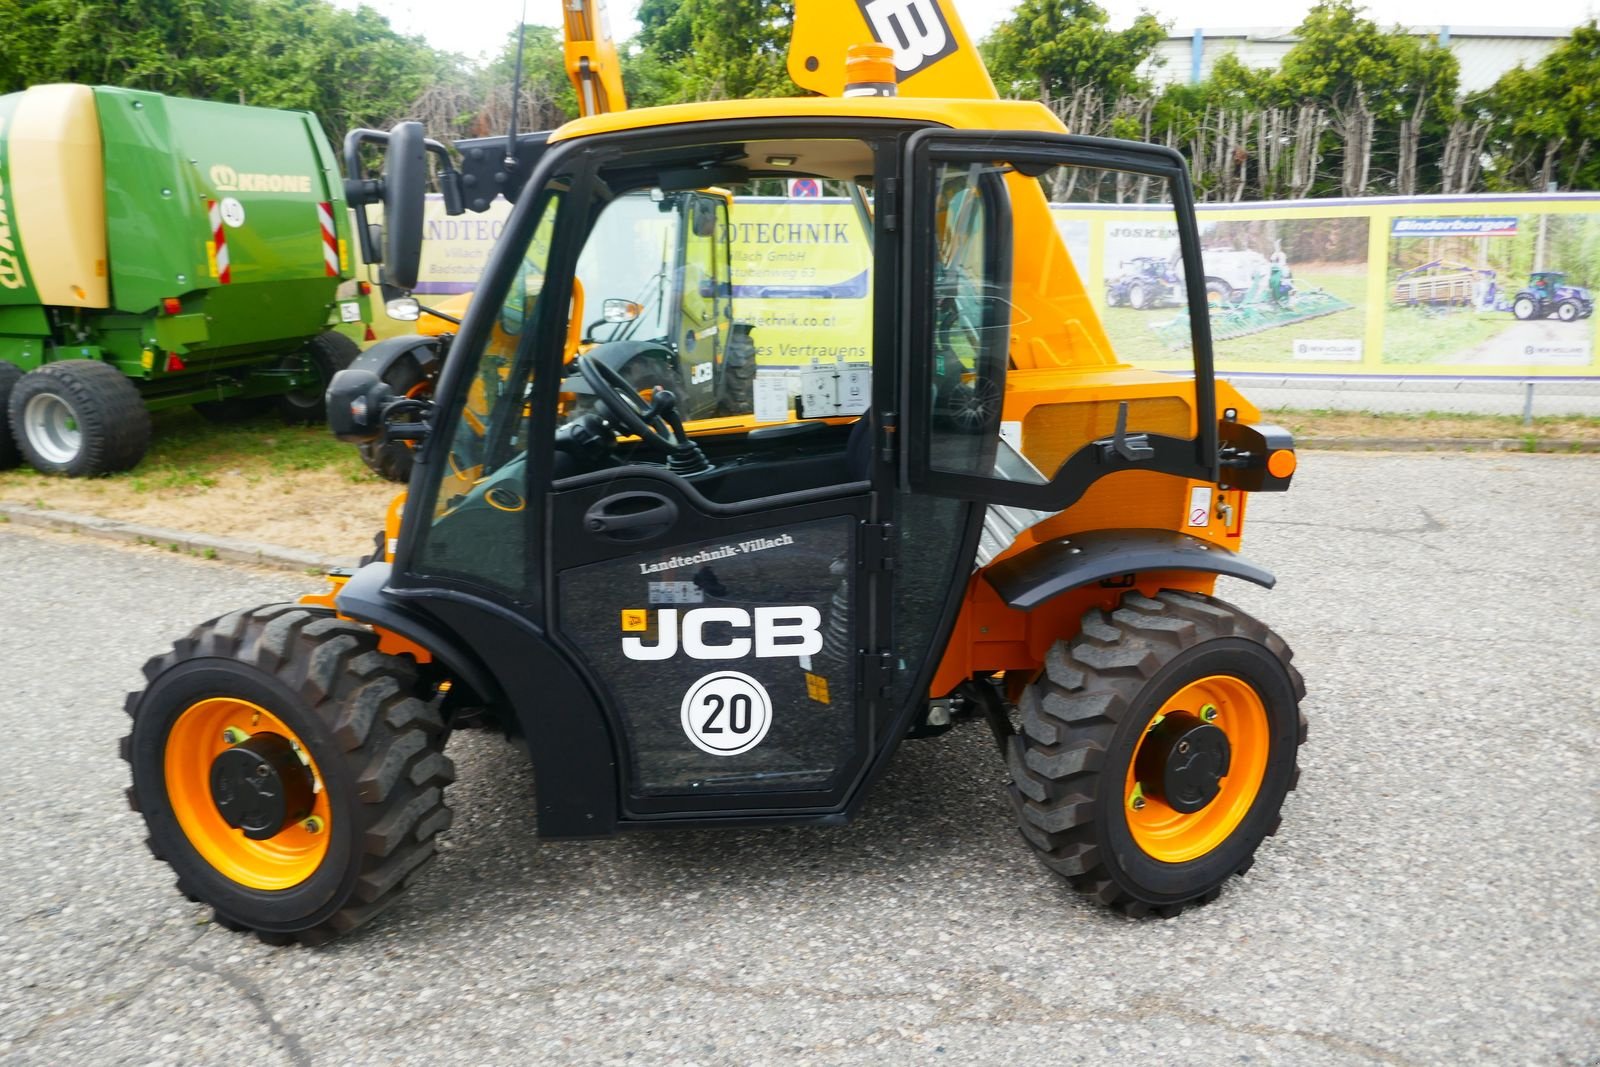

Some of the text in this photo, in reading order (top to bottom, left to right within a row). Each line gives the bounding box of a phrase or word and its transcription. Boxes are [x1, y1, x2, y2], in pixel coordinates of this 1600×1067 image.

[238, 173, 312, 193] KRONE
[422, 220, 504, 241] NDTEC
[767, 251, 806, 262] GmbH
[756, 343, 866, 357] es Vertrauens
[640, 533, 794, 575] Landtechnik-Villach
[621, 605, 824, 661] JCB
[702, 693, 752, 735] 20
